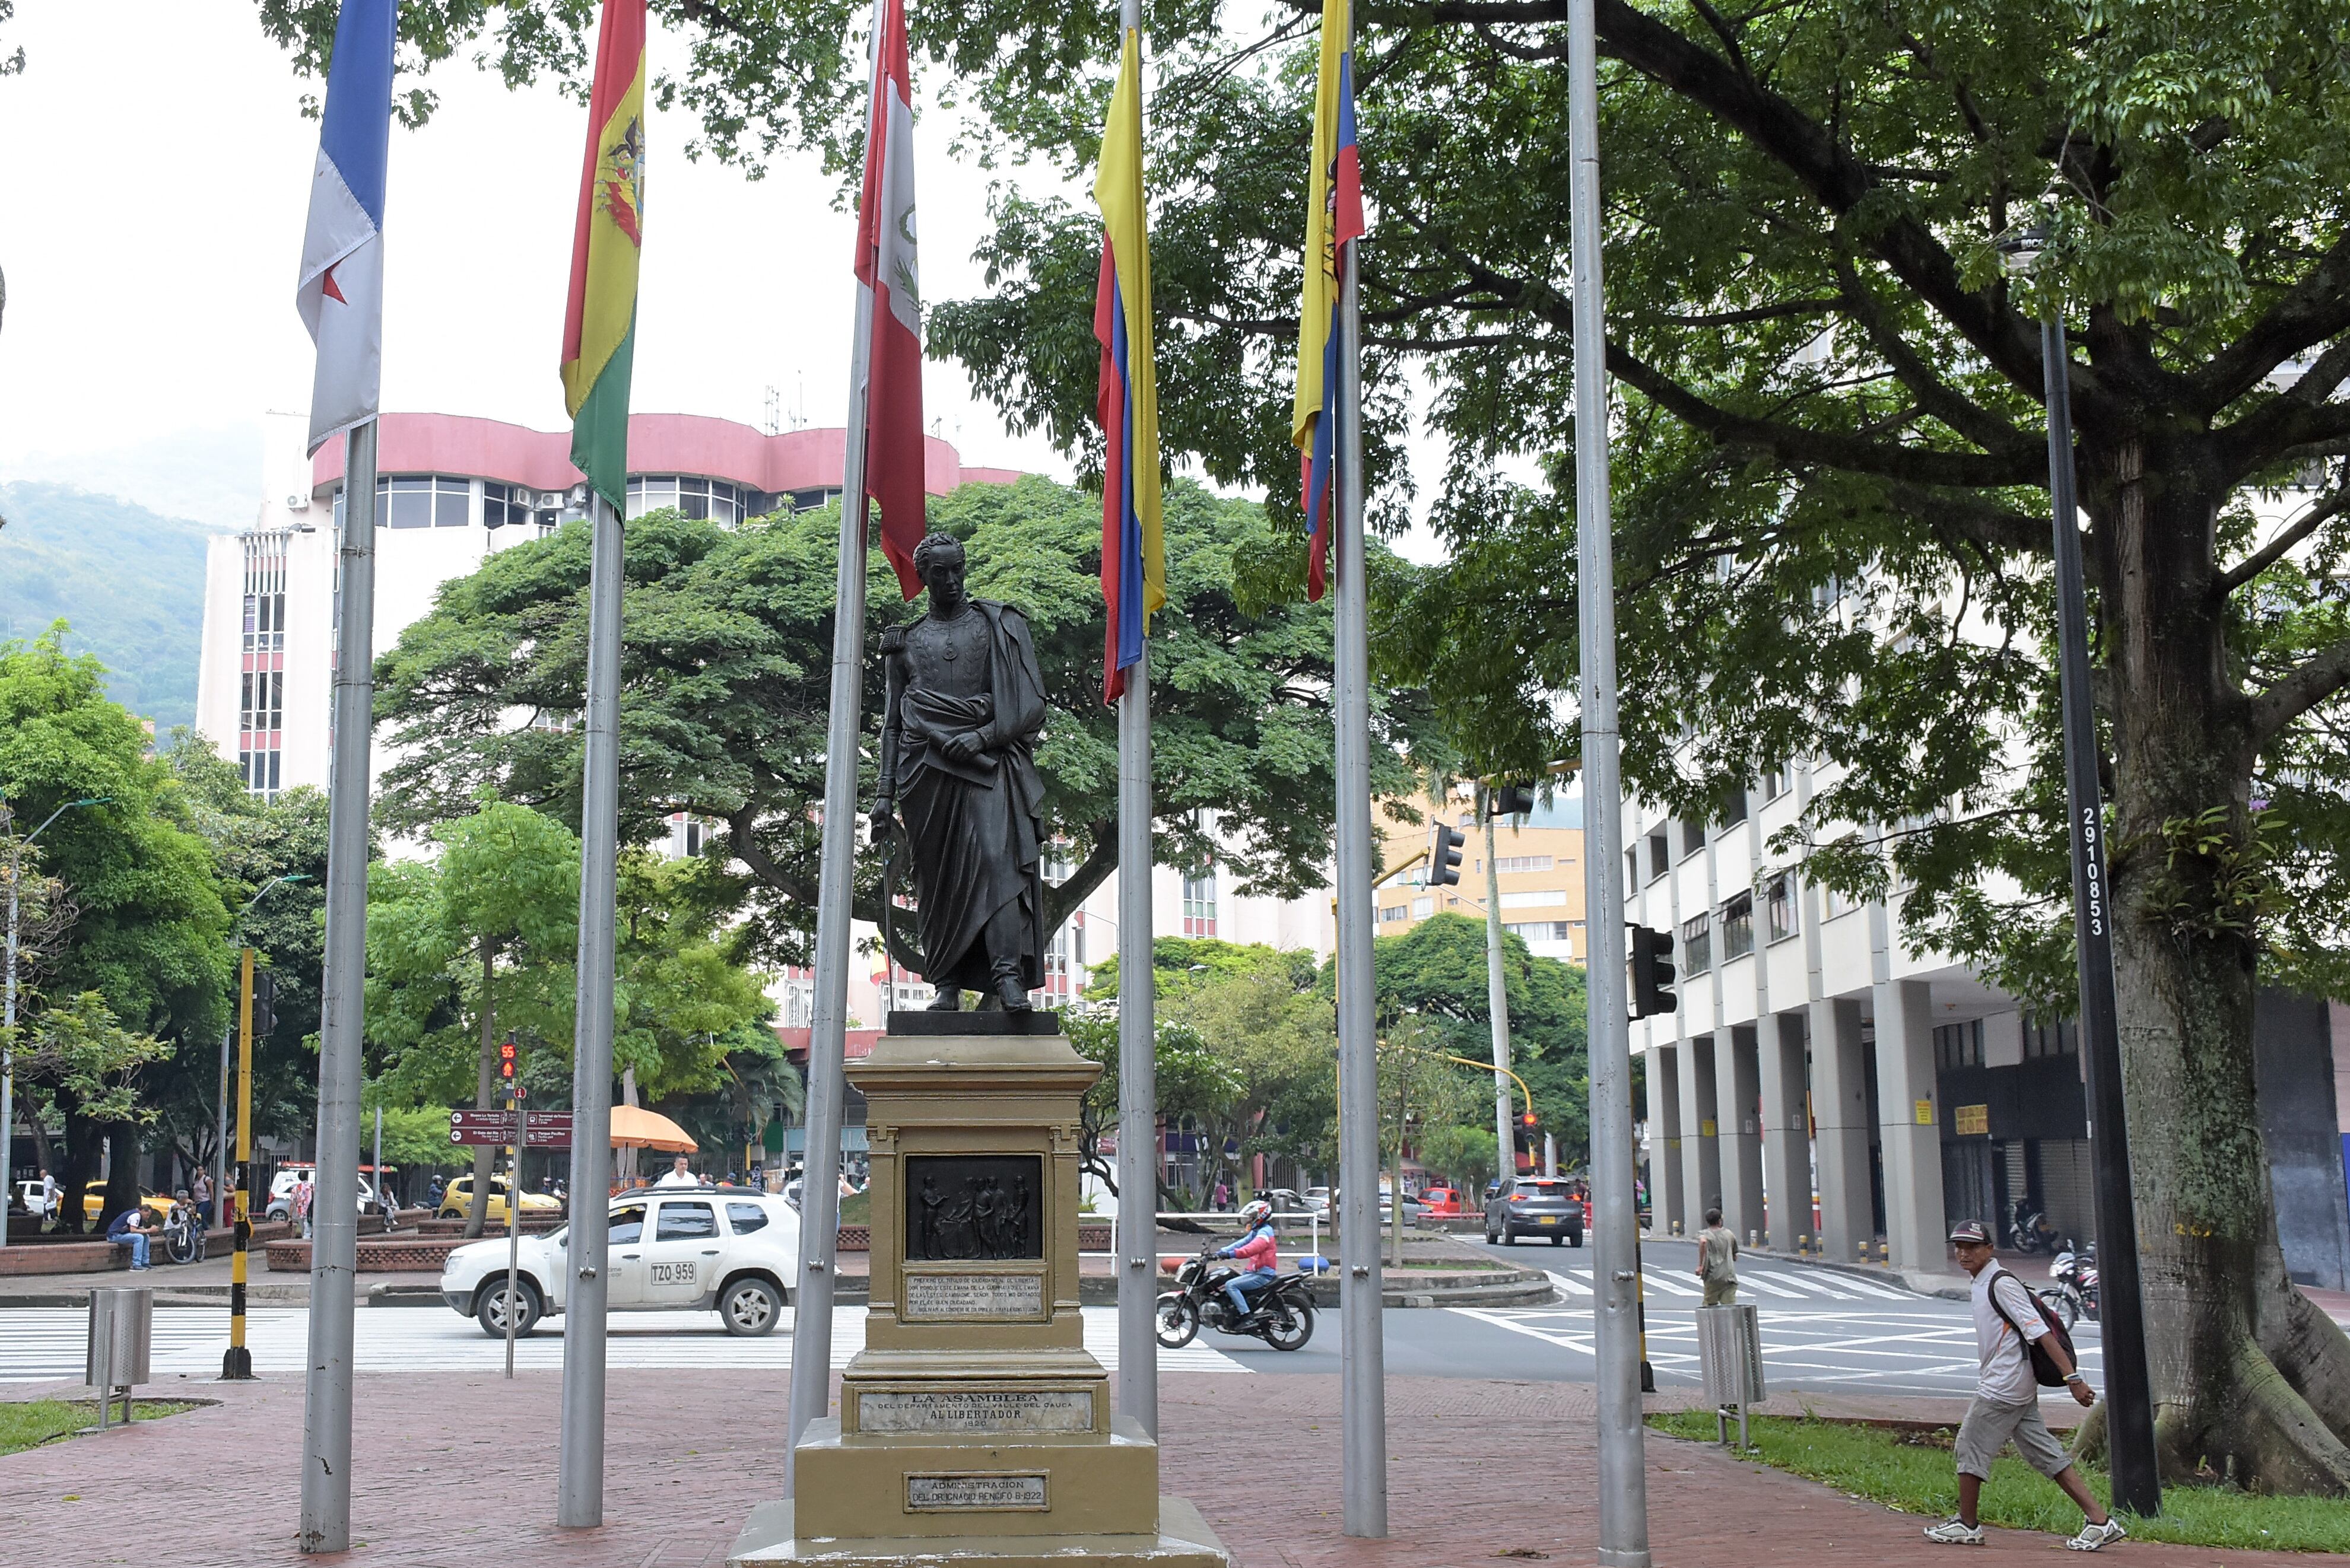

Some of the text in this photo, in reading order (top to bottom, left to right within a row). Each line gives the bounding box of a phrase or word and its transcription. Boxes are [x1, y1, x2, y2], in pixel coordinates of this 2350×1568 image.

[2083, 807, 2102, 936] 2910853
[501, 1046, 515, 1058] 55
[941, 1394, 1038, 1402] ASAMBLEA
[931, 1410, 1021, 1419] AL LIBERTADOR
[946, 1493, 976, 1501] IGNACIO
